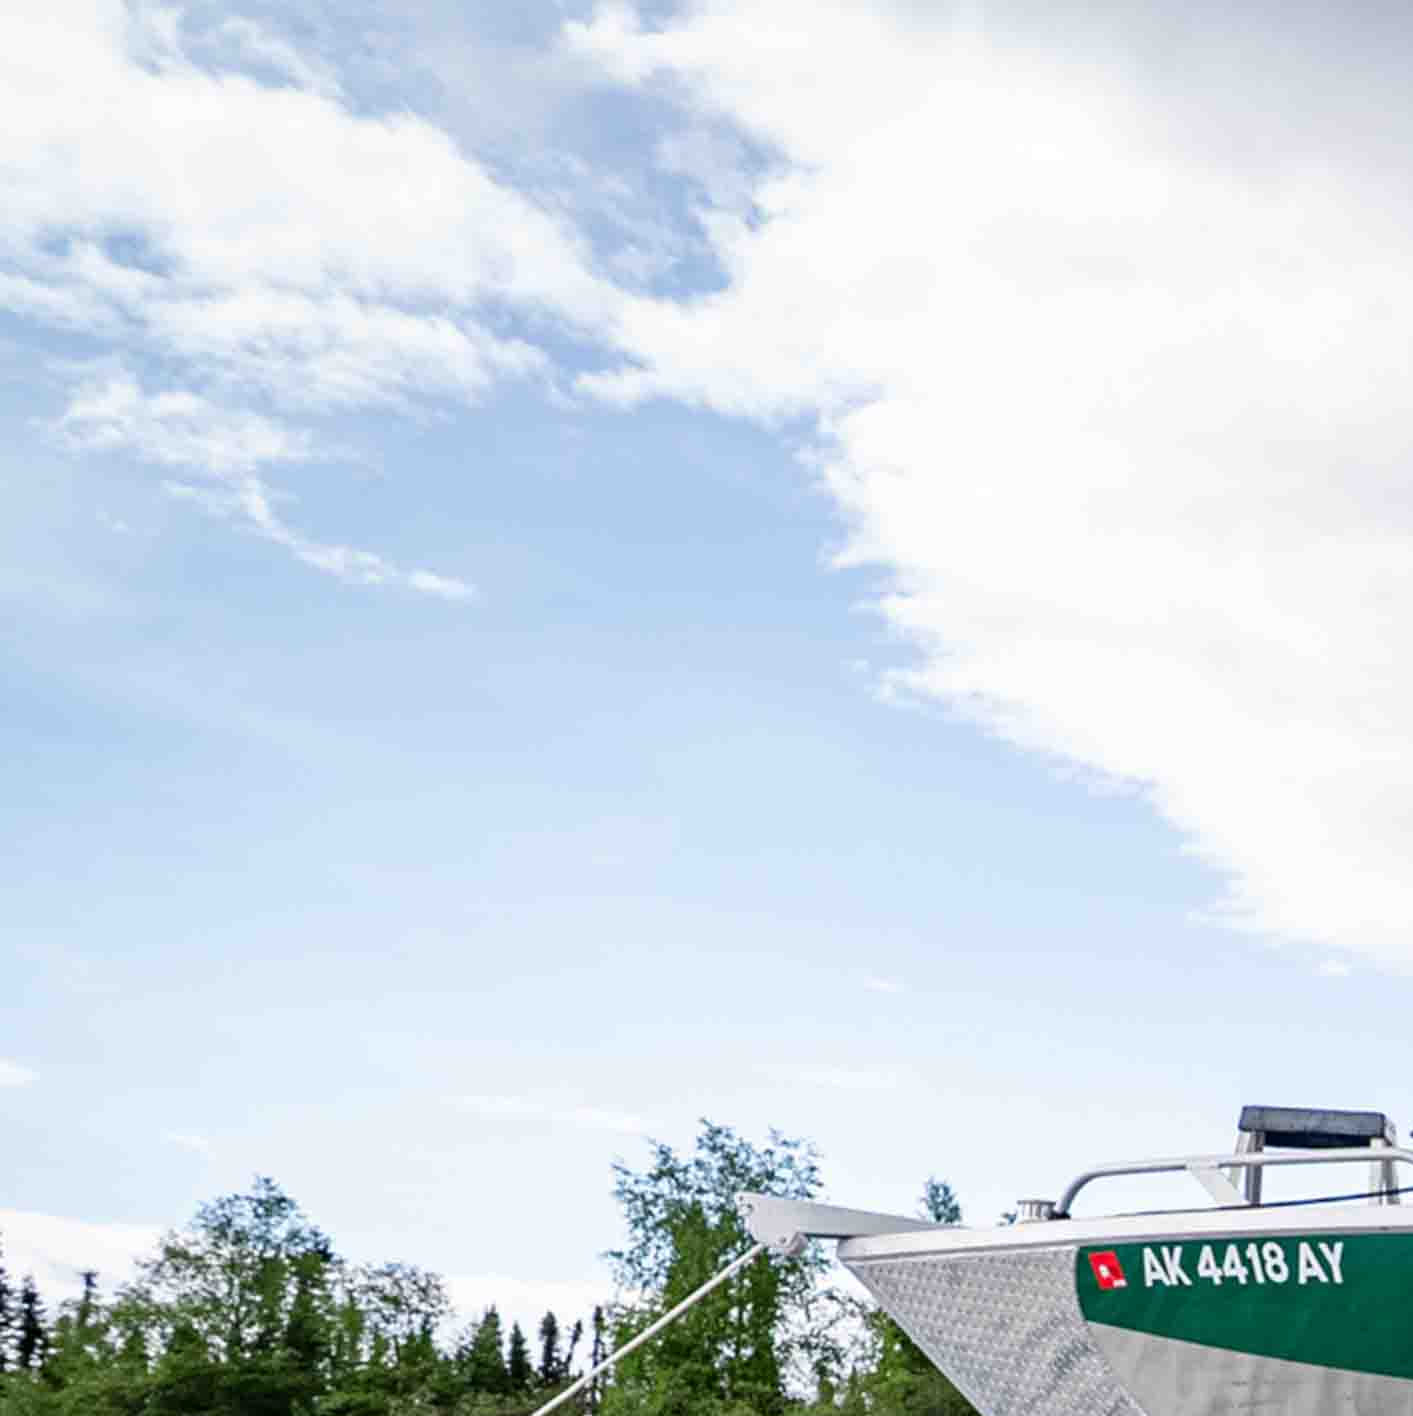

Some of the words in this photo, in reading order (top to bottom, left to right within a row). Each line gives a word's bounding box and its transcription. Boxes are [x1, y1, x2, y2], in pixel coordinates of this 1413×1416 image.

[1143, 1246, 1193, 1287] AK
[1197, 1242, 1289, 1286] 4418
[1298, 1242, 1344, 1284] AY
